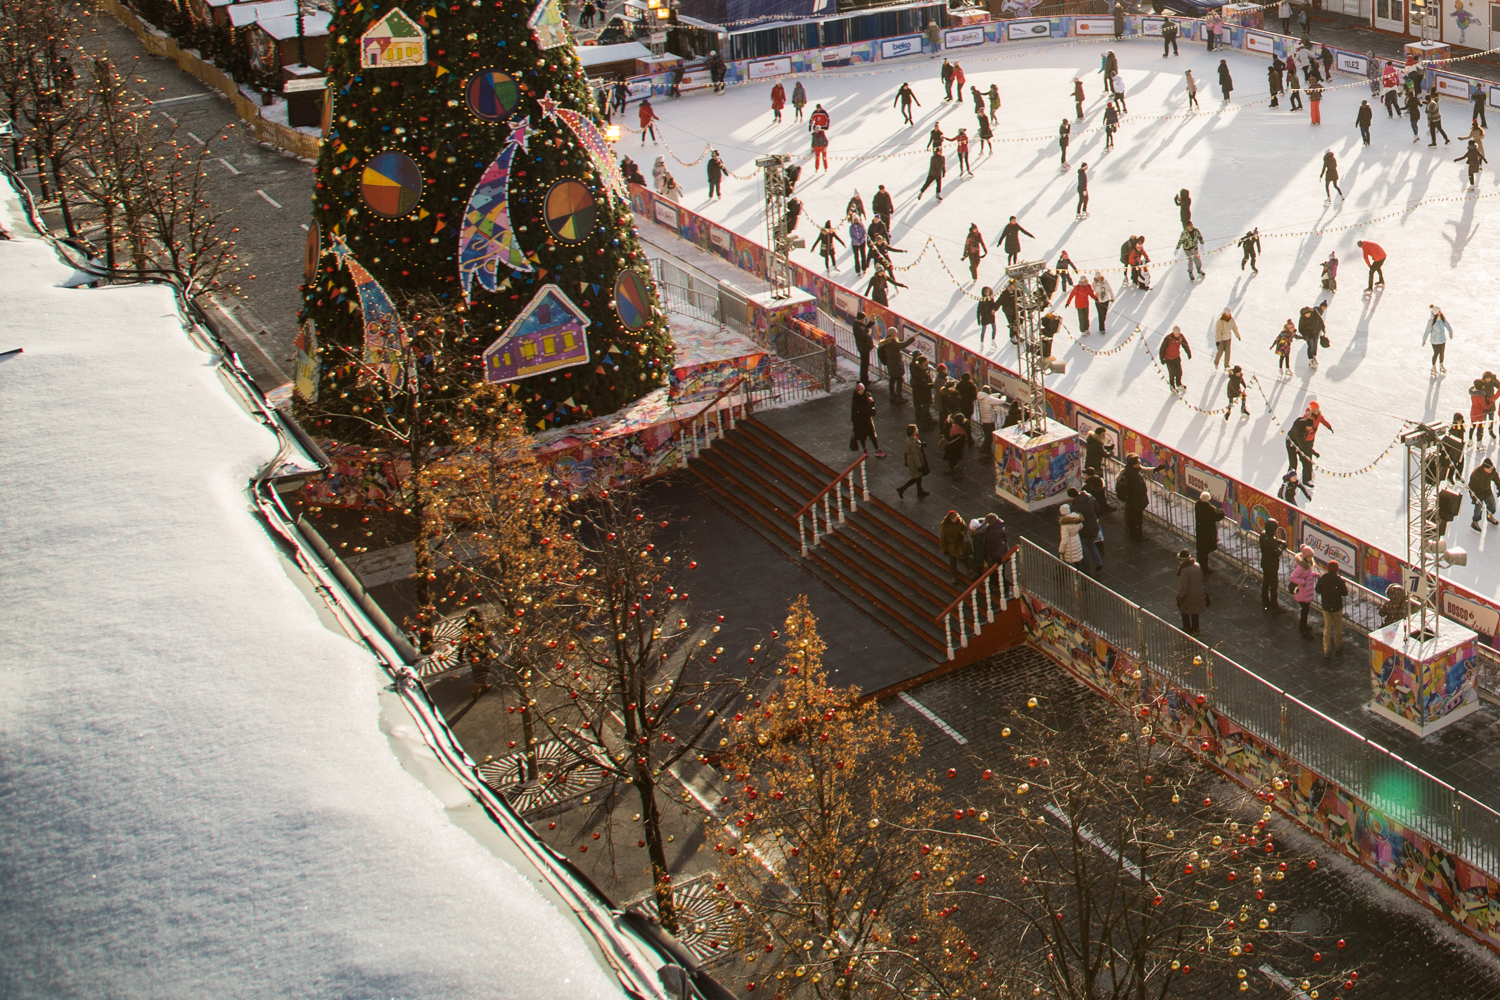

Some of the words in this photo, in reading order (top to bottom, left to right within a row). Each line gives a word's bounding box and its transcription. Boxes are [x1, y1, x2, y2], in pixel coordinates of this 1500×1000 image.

[892, 42, 911, 50] beko
[1344, 60, 1360, 70] TELE2
[1188, 474, 1204, 491] BOSCO
[1447, 601, 1468, 622] BOSCO
[1471, 620, 1492, 636] fresh
